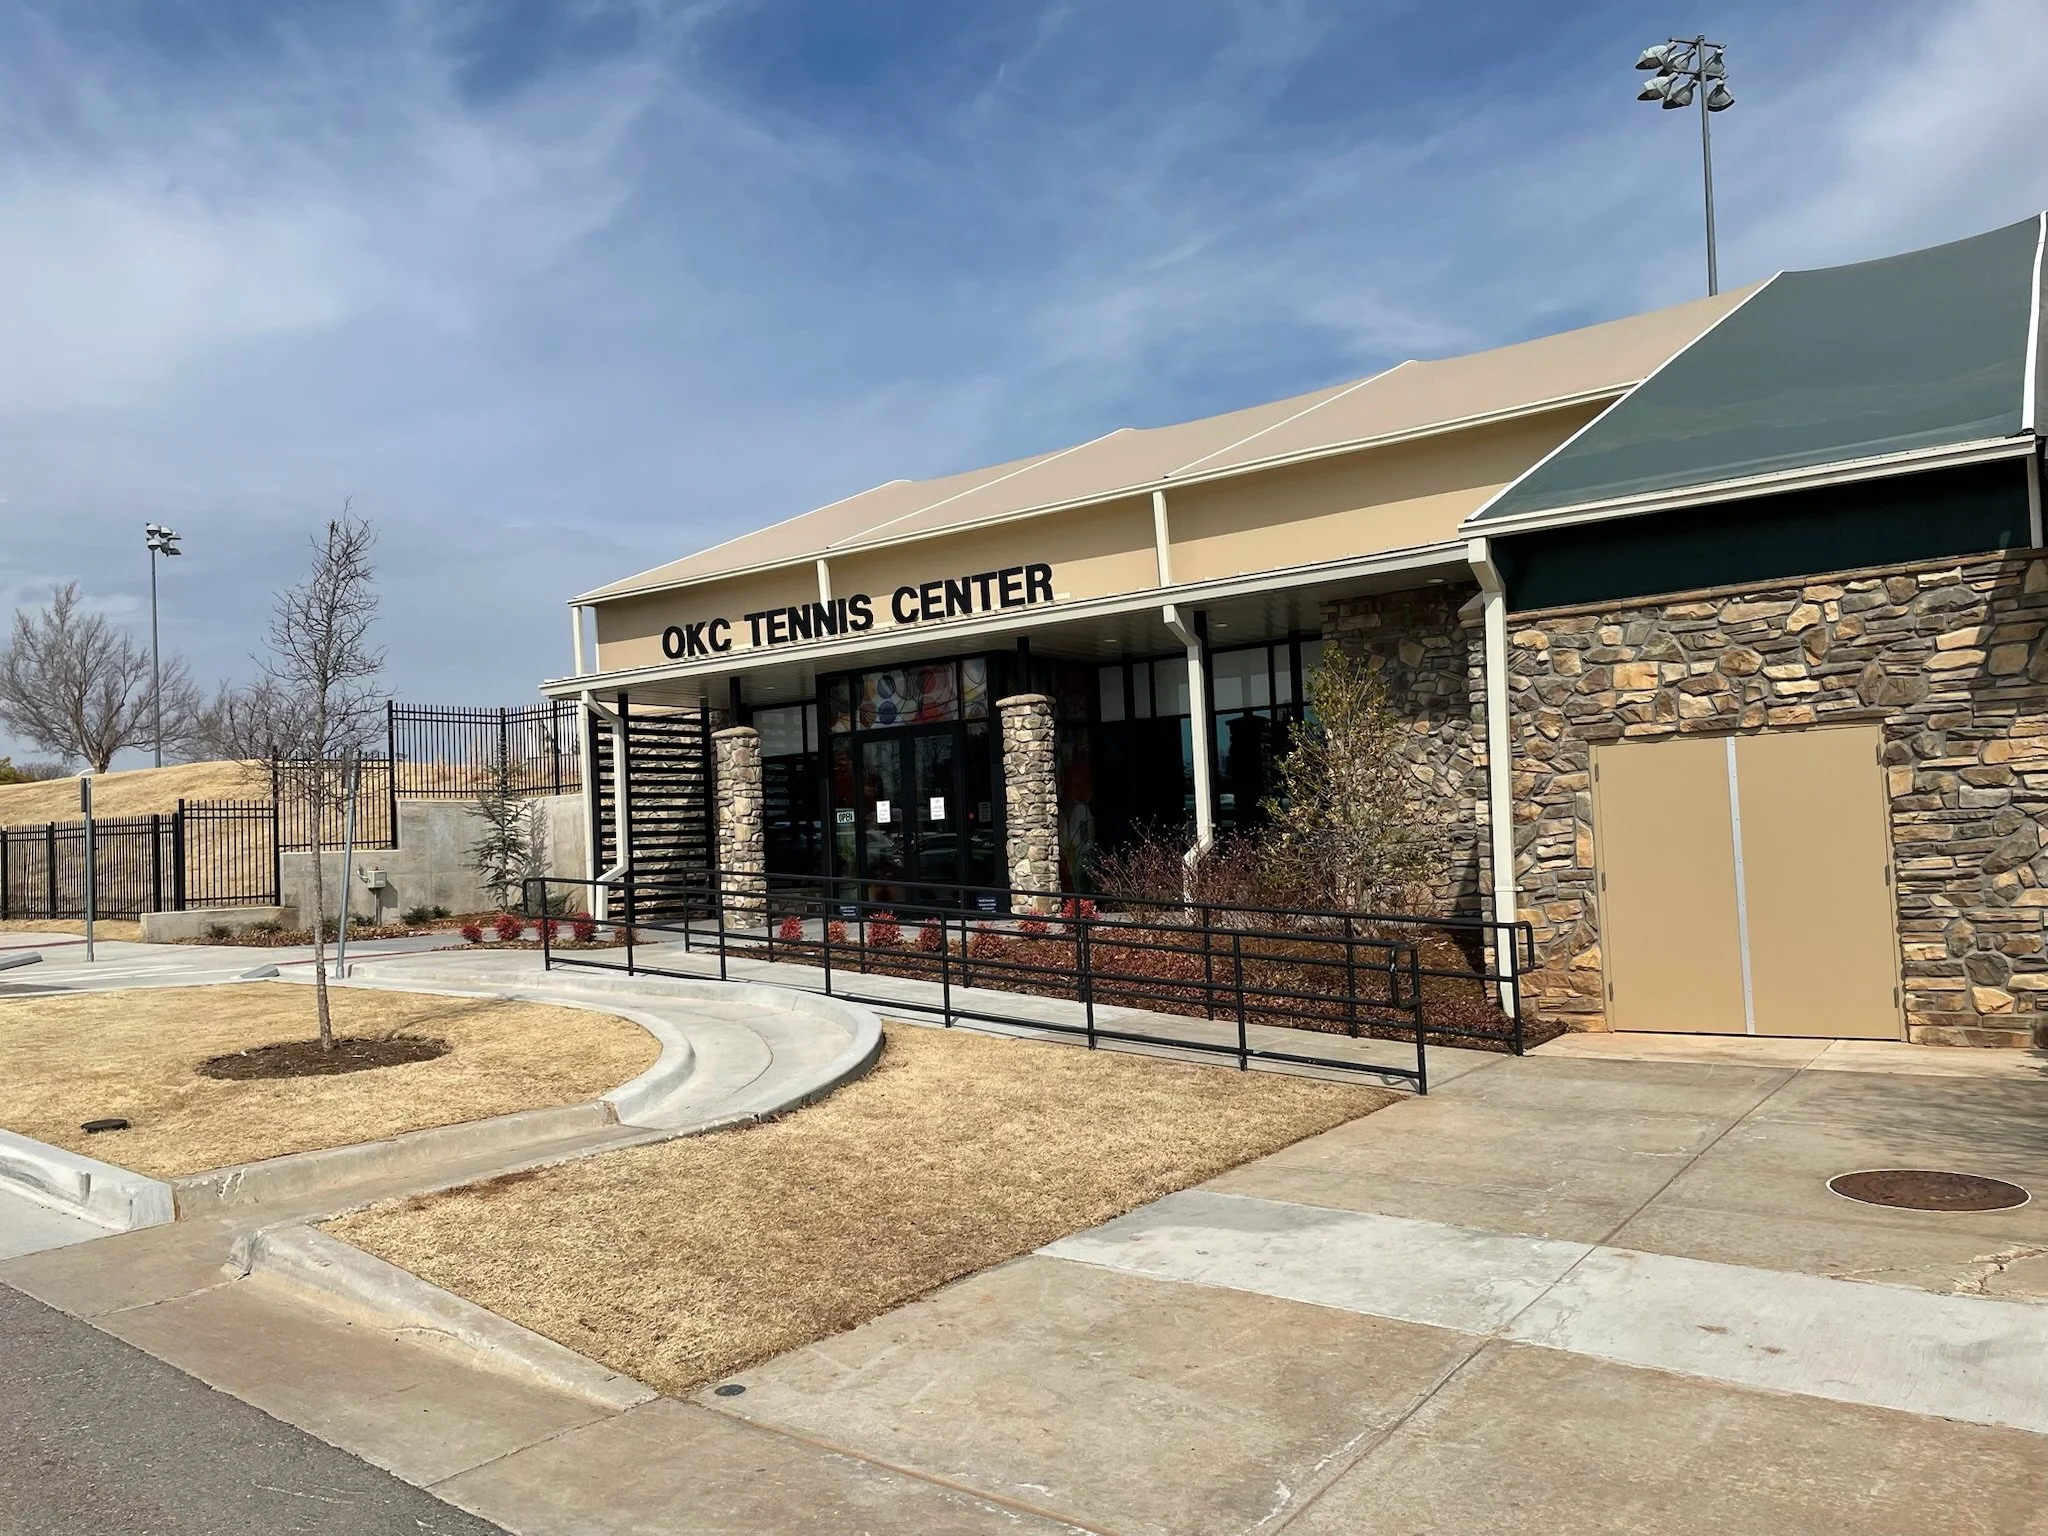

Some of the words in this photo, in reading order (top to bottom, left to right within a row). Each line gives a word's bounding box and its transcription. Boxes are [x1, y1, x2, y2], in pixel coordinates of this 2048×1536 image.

[662, 618, 731, 659] OKC
[745, 595, 873, 647] TENNIS
[892, 564, 1053, 623] CENTER
